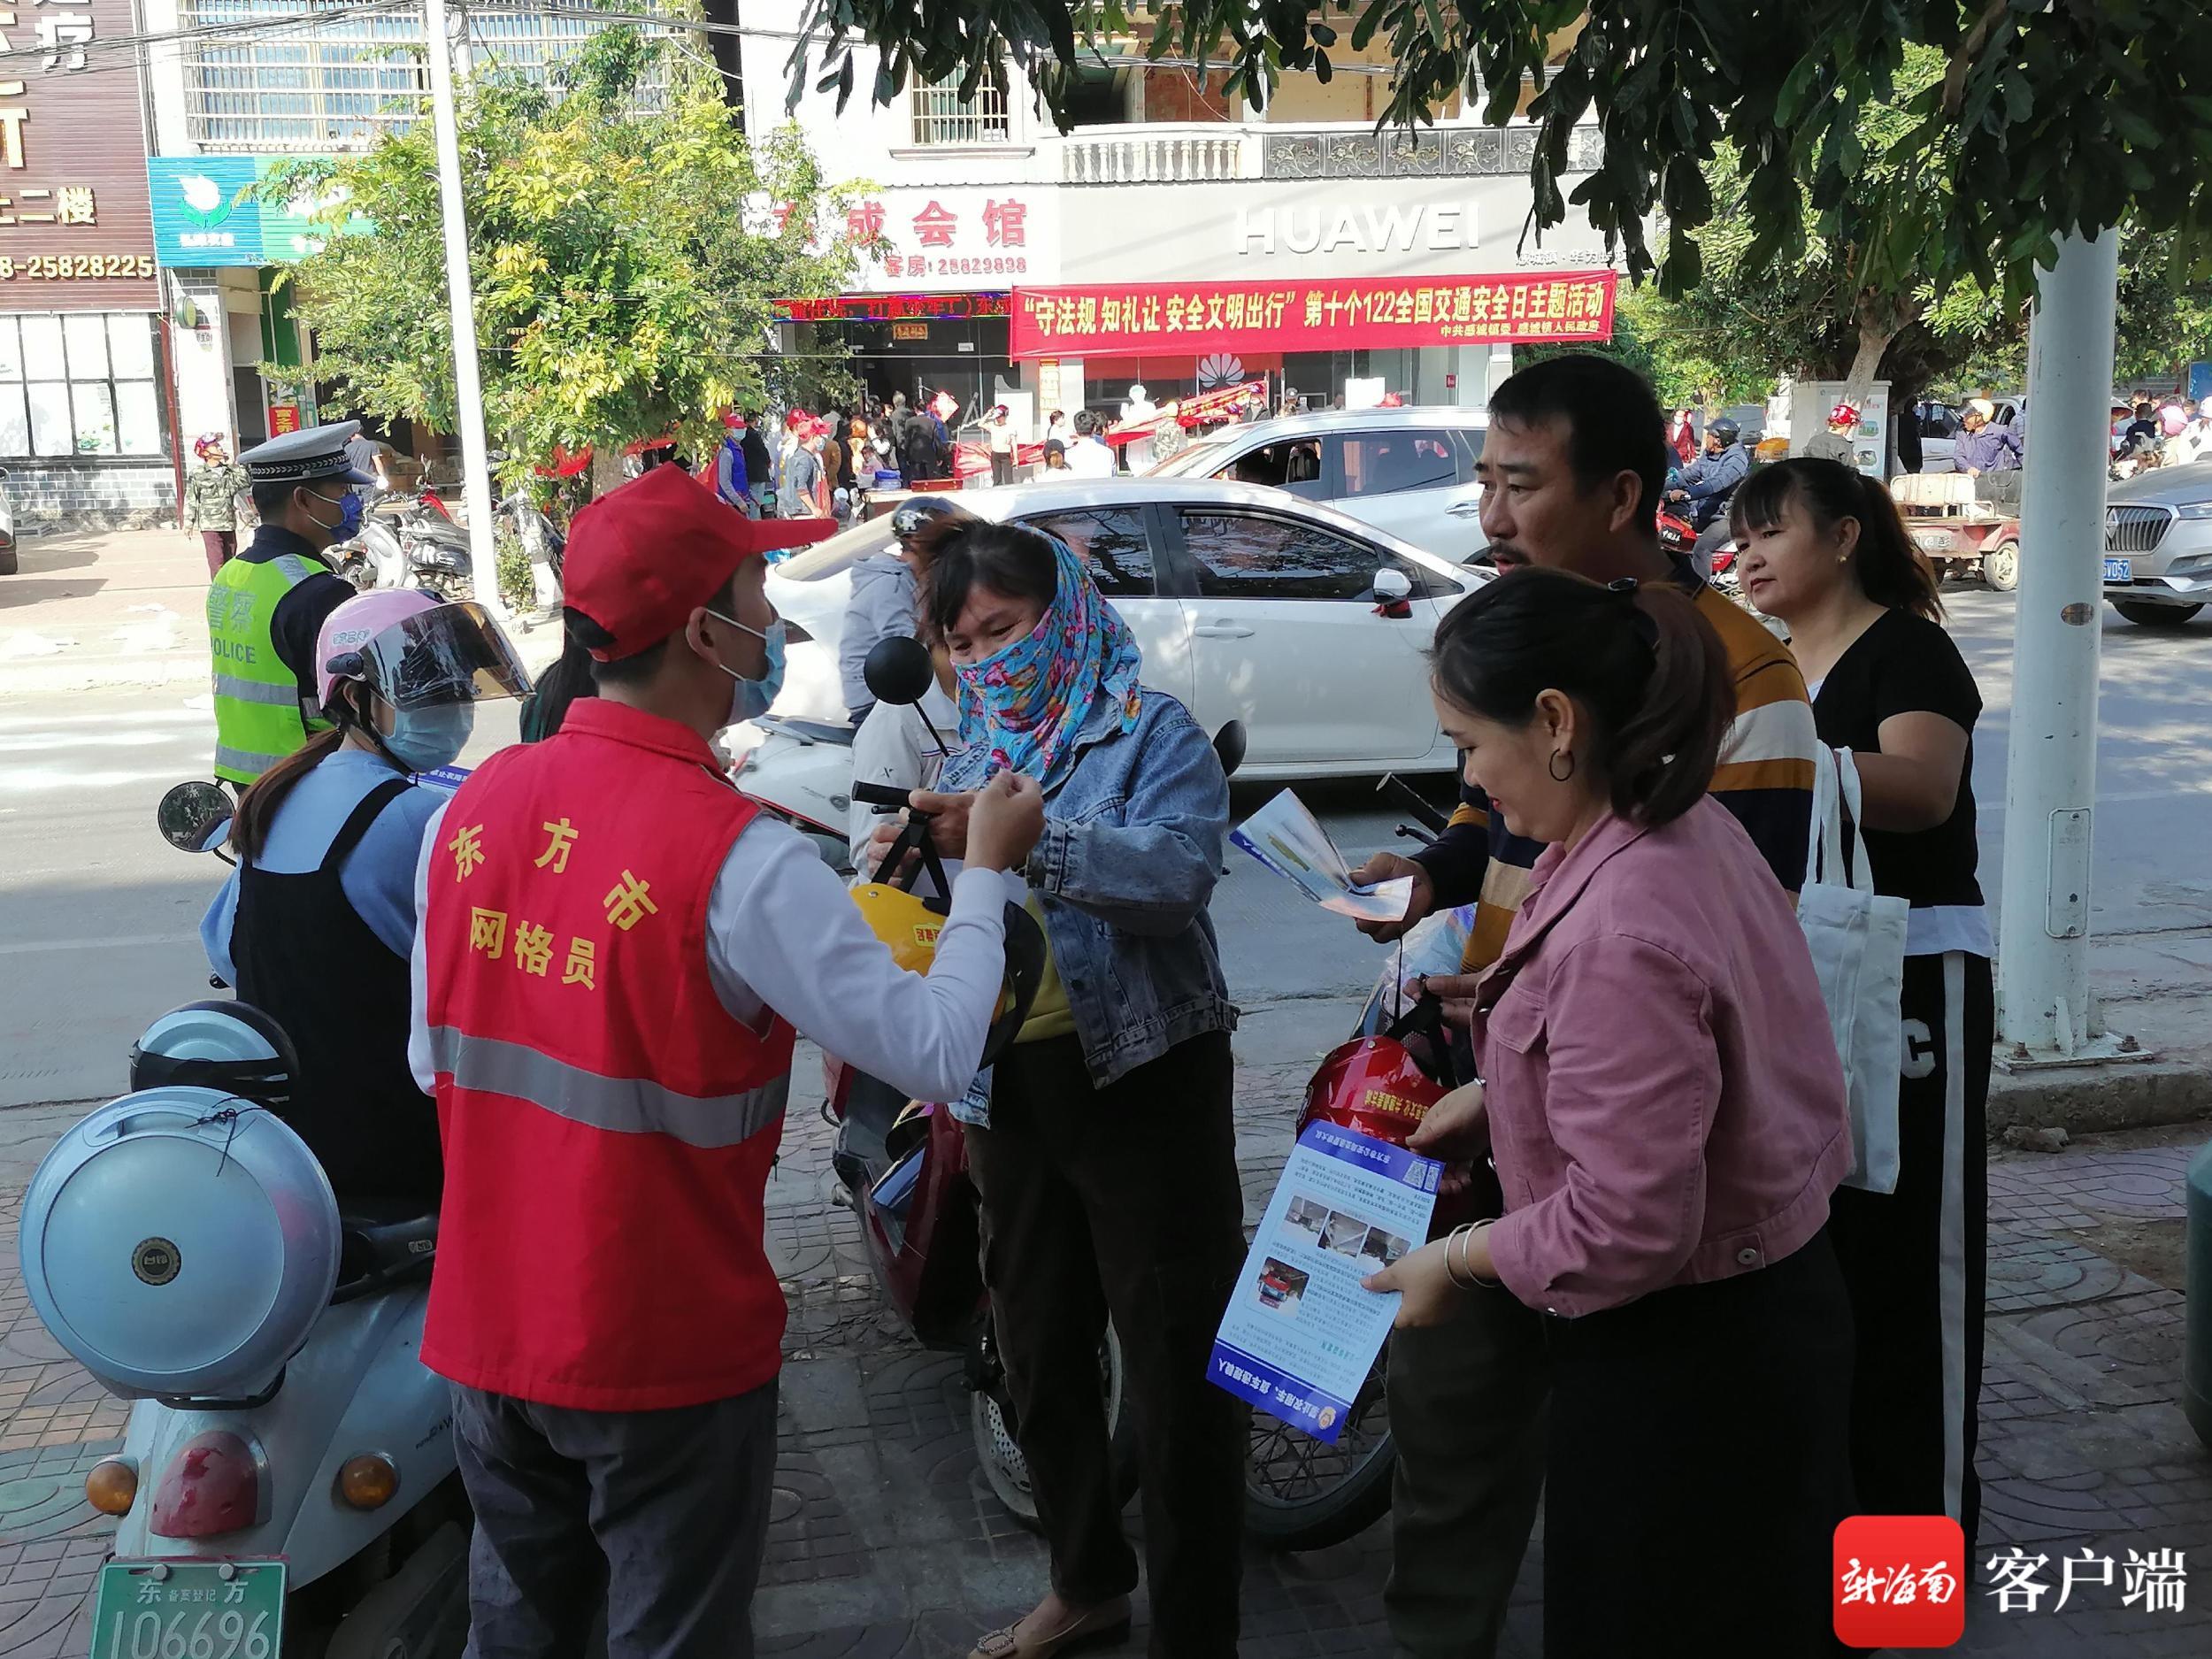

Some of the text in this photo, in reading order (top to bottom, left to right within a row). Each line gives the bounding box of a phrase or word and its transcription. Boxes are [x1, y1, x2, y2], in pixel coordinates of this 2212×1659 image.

[1237, 203, 1479, 255] HUAWEI
[1101, 295, 1161, 334] 知礼让
[1303, 280, 1605, 327] 第十个122全国交通安全日主题活动
[212, 638, 257, 664] OLICE
[448, 818, 658, 931] 东方市
[470, 906, 596, 991] 网格员
[110, 1609, 269, 1659] 106696
